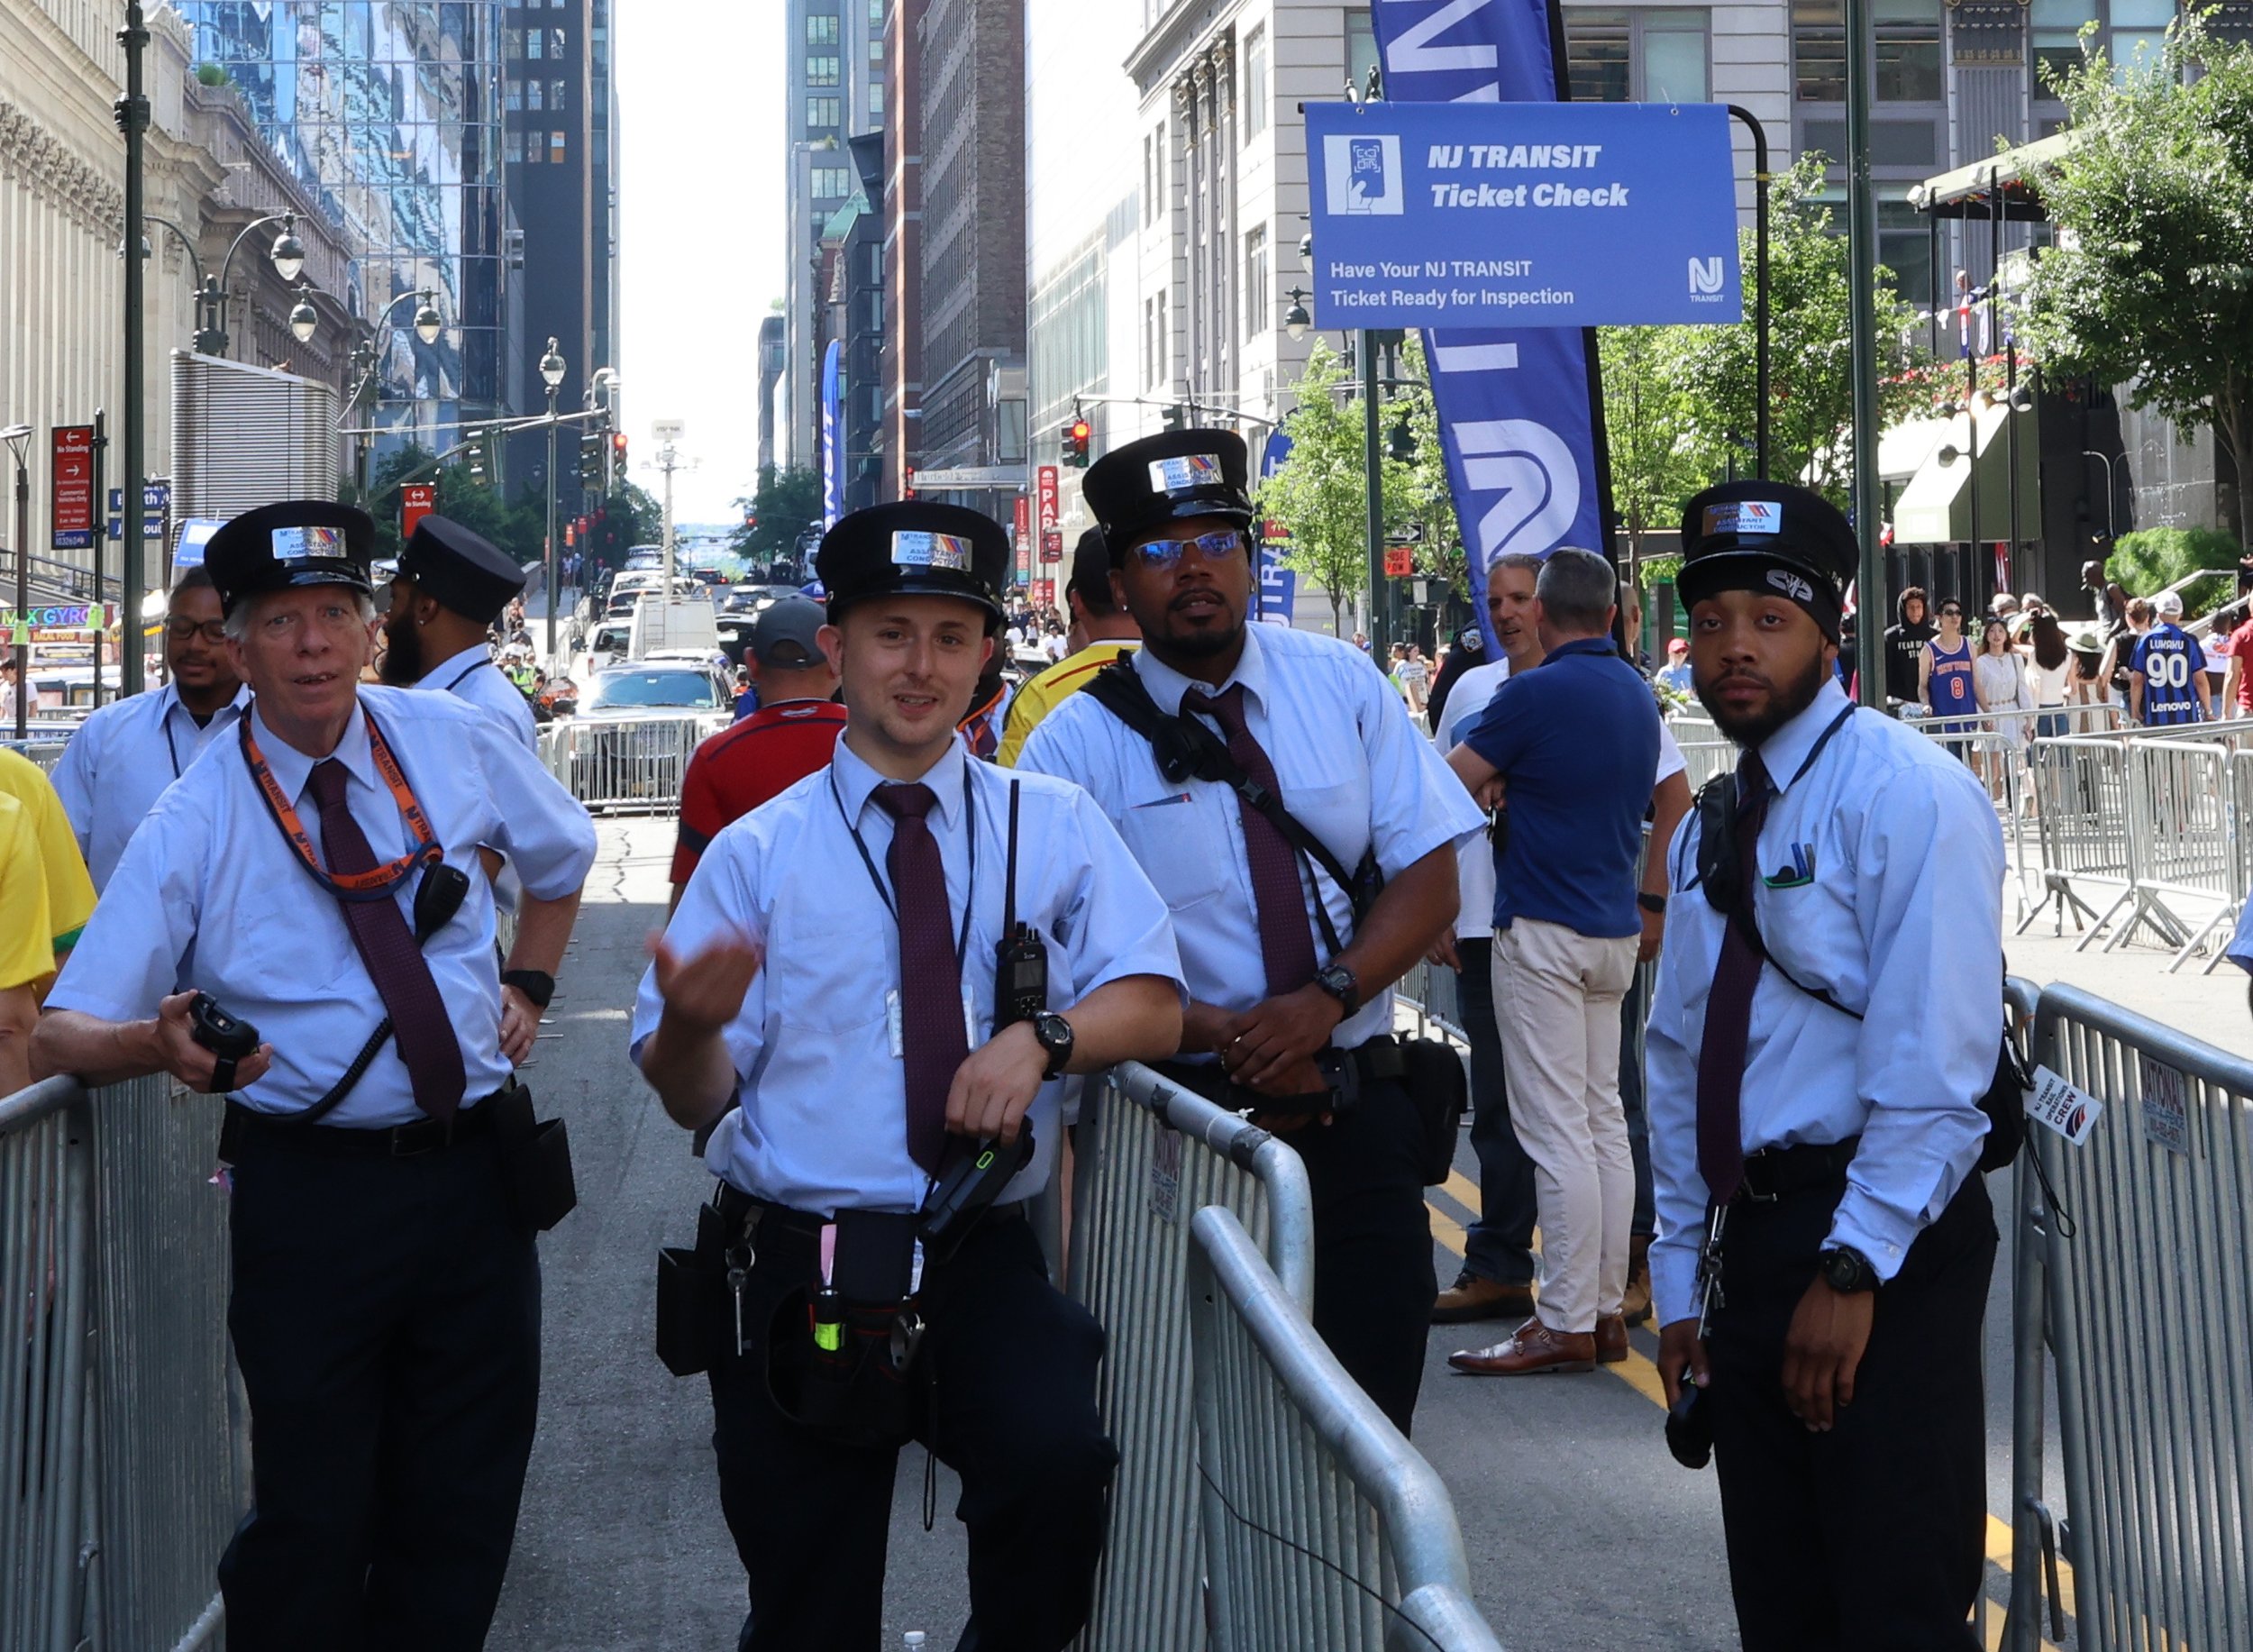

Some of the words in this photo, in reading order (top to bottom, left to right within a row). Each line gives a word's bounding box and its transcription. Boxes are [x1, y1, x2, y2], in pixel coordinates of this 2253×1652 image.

[1428, 145, 1464, 169] NJ
[1469, 144, 1601, 169] TRANSIT
[1431, 183, 1528, 207] Ticket
[1533, 183, 1629, 207] Check
[1330, 262, 1374, 278] Have
[1380, 261, 1419, 278] Your
[1426, 261, 1446, 278] NJ
[1451, 260, 1532, 277] TRANSIT
[1688, 257, 1724, 294] NJ
[1331, 290, 1386, 306] Ticket
[1391, 288, 1446, 309] Ready
[1451, 288, 1476, 305] for
[1481, 287, 1574, 308] Inspection
[66, 445, 88, 453] Standing
[57, 632, 75, 641] FOOD
[2149, 639, 2184, 650] LUKAKU
[2146, 653, 2188, 688] 90
[1950, 677, 1965, 699] 8
[2151, 701, 2191, 713] Lenovo
[259, 771, 292, 814] TRANSIT
[2033, 1102, 2042, 1111] NJ
[2039, 1078, 2055, 1103] TRANSIT
[2045, 1084, 2068, 1120] OPERATIONS
[2046, 1092, 2057, 1106] RAIL
[2054, 1091, 2076, 1125] CREW
